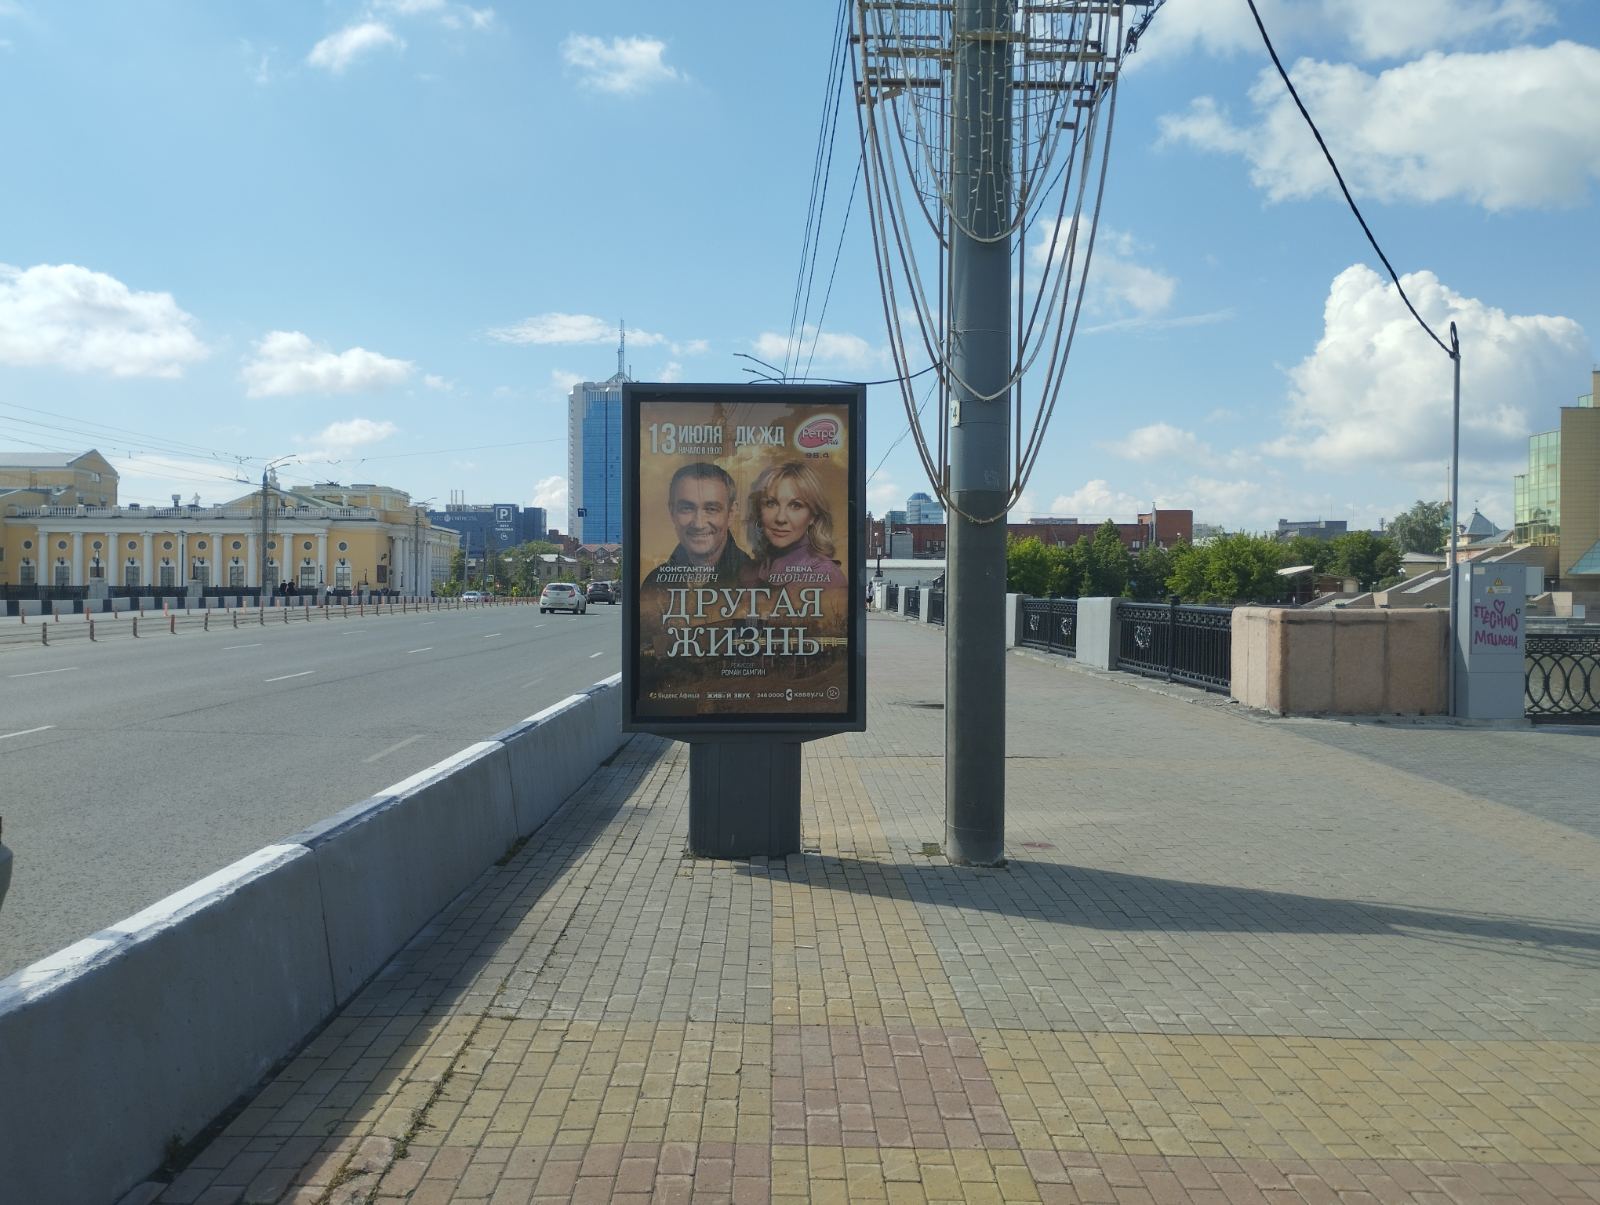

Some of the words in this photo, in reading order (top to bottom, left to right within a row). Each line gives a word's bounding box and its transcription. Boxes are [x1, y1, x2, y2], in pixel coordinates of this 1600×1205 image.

[649, 422, 676, 455] 13
[678, 425, 723, 444] ИЮЛЯ
[735, 425, 756, 446] ДК
[759, 425, 785, 446] ЖД
[678, 446, 701, 455] НАЧАЛО
[659, 565, 716, 573] КОНСТАНТИН
[785, 565, 813, 573] ЕЛЕНА
[655, 573, 719, 583] ЮШКЕВИЧ
[768, 573, 832, 583] ЯКОВЛЕВА
[662, 587, 824, 625] ДРУГАЯ
[667, 626, 820, 657] ЖИЗНЬ
[721, 669, 742, 677] РОМАН
[742, 669, 766, 677] САМГИН
